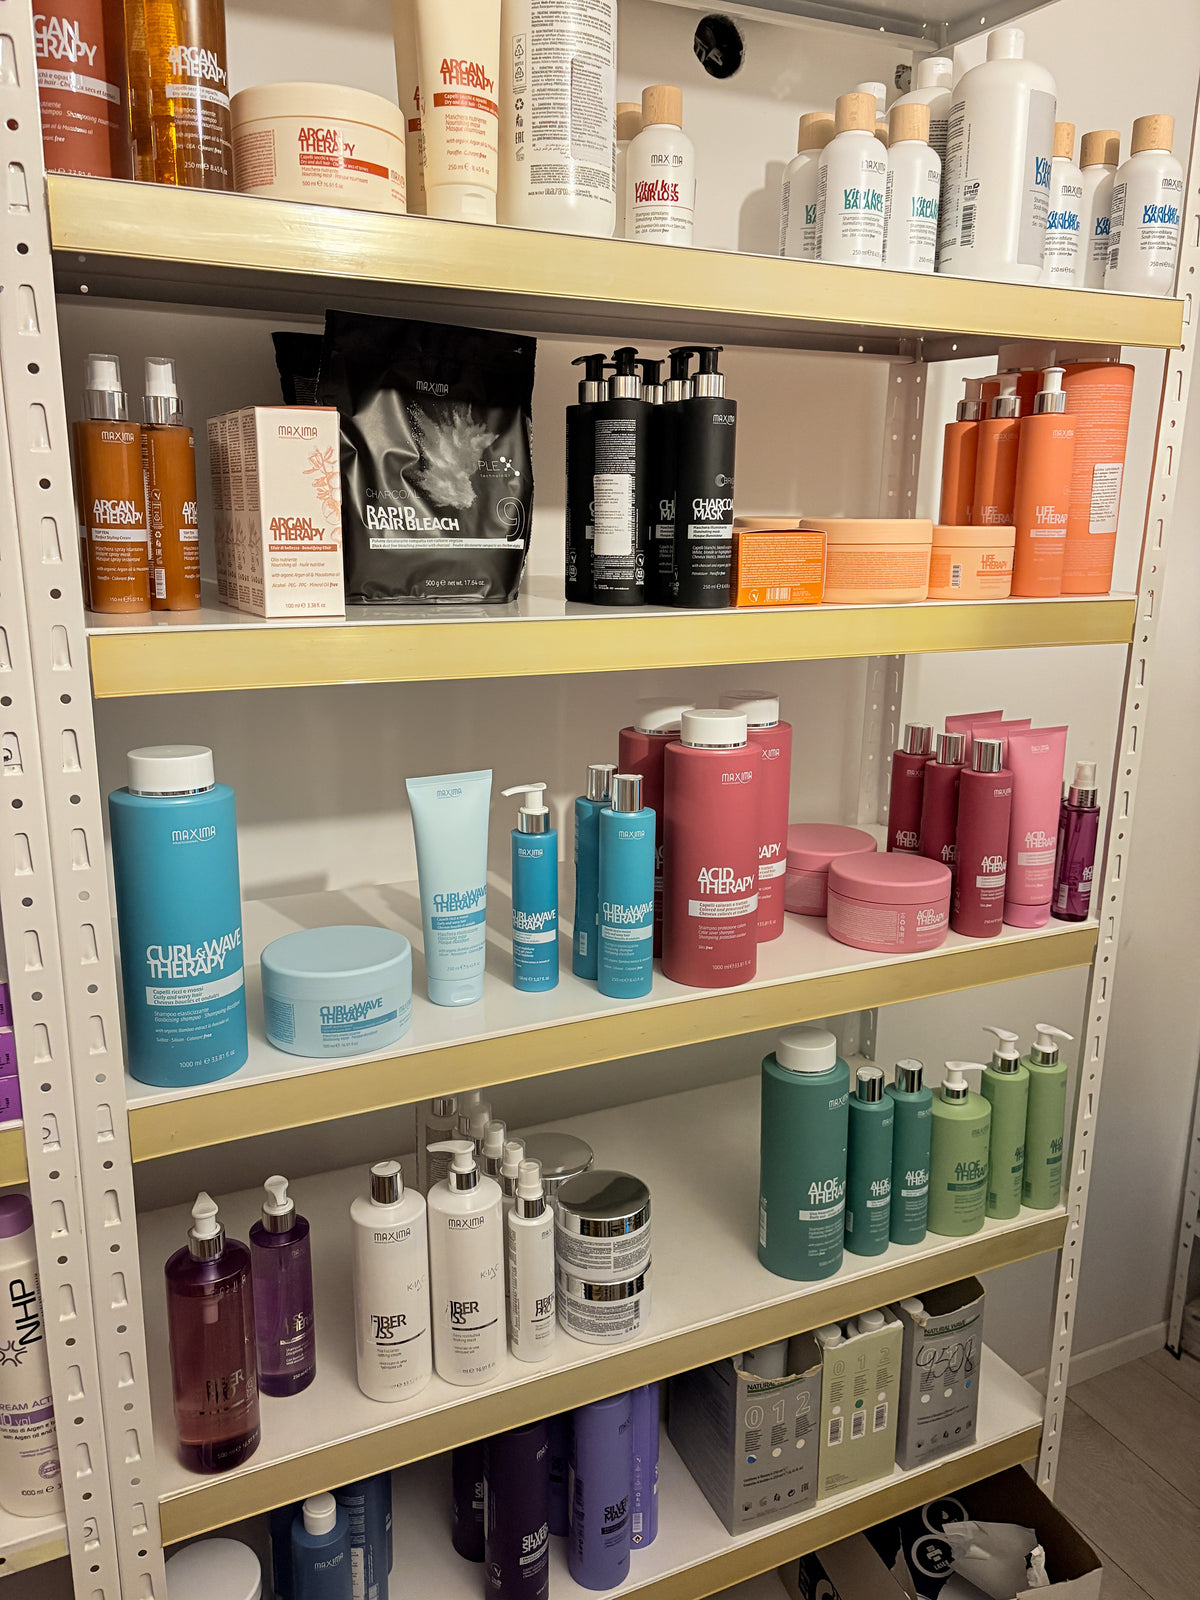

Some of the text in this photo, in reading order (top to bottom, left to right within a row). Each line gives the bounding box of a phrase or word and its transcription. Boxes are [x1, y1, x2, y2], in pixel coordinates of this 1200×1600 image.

[168, 46, 217, 68] ARGAN
[170, 61, 227, 86] THERAPY
[440, 58, 485, 79] ARGAN
[442, 70, 495, 93] THERAPY
[299, 140, 355, 157] THERAPY
[635, 190, 679, 203] HAIR LOSS
[416, 380, 449, 394] MAXIMA
[101, 431, 135, 443] MAXIMA
[278, 425, 318, 439] MAXIMA
[366, 487, 421, 500] CHARCOAL
[92, 499, 136, 514] ARGAN
[366, 505, 416, 519] RAPID
[1035, 506, 1055, 516] LIFE
[94, 511, 143, 525] THERAPY
[496, 496, 525, 542] 9
[694, 509, 724, 521] MASK
[269, 517, 312, 531] ARGAN
[368, 517, 460, 531] HAIR BLEACH
[272, 528, 325, 541] THERAPY
[981, 554, 996, 563] LIFE
[981, 560, 1007, 570] THERAPY
[721, 770, 753, 784] MAXIMA
[436, 788, 463, 800] MAXIMA
[172, 825, 217, 843] MAXIMA
[618, 830, 646, 842] MAXIMA
[896, 830, 918, 841] ACID
[1025, 831, 1046, 842] ACID
[518, 848, 544, 859] MAXIMA
[981, 855, 1003, 867] ACID
[697, 867, 735, 882] ACID
[699, 876, 756, 894] THERAPY
[434, 897, 479, 913] THERAPY
[602, 900, 654, 915] CURL&WAVE
[603, 911, 645, 924] THERAPY
[917, 909, 935, 920] ACID
[146, 927, 241, 964] CURL&WAVE
[147, 952, 228, 980] THERAPY
[154, 1010, 176, 1018] Shampoo
[319, 997, 383, 1017] CURL&WAVE
[320, 1009, 369, 1024] THERAPY
[179, 1061, 194, 1069] 1000
[954, 1159, 981, 1173] ALOE
[905, 1169, 926, 1180] ALOE
[808, 1176, 839, 1196] ALOE
[448, 1215, 484, 1230] MAXIMA
[373, 1227, 411, 1242] MAXIMA
[8, 1278, 44, 1346] NHP
[448, 1300, 480, 1315] IBER
[744, 1391, 811, 1429] 0 1 2
[314, 1552, 344, 1571] MAXIMA
